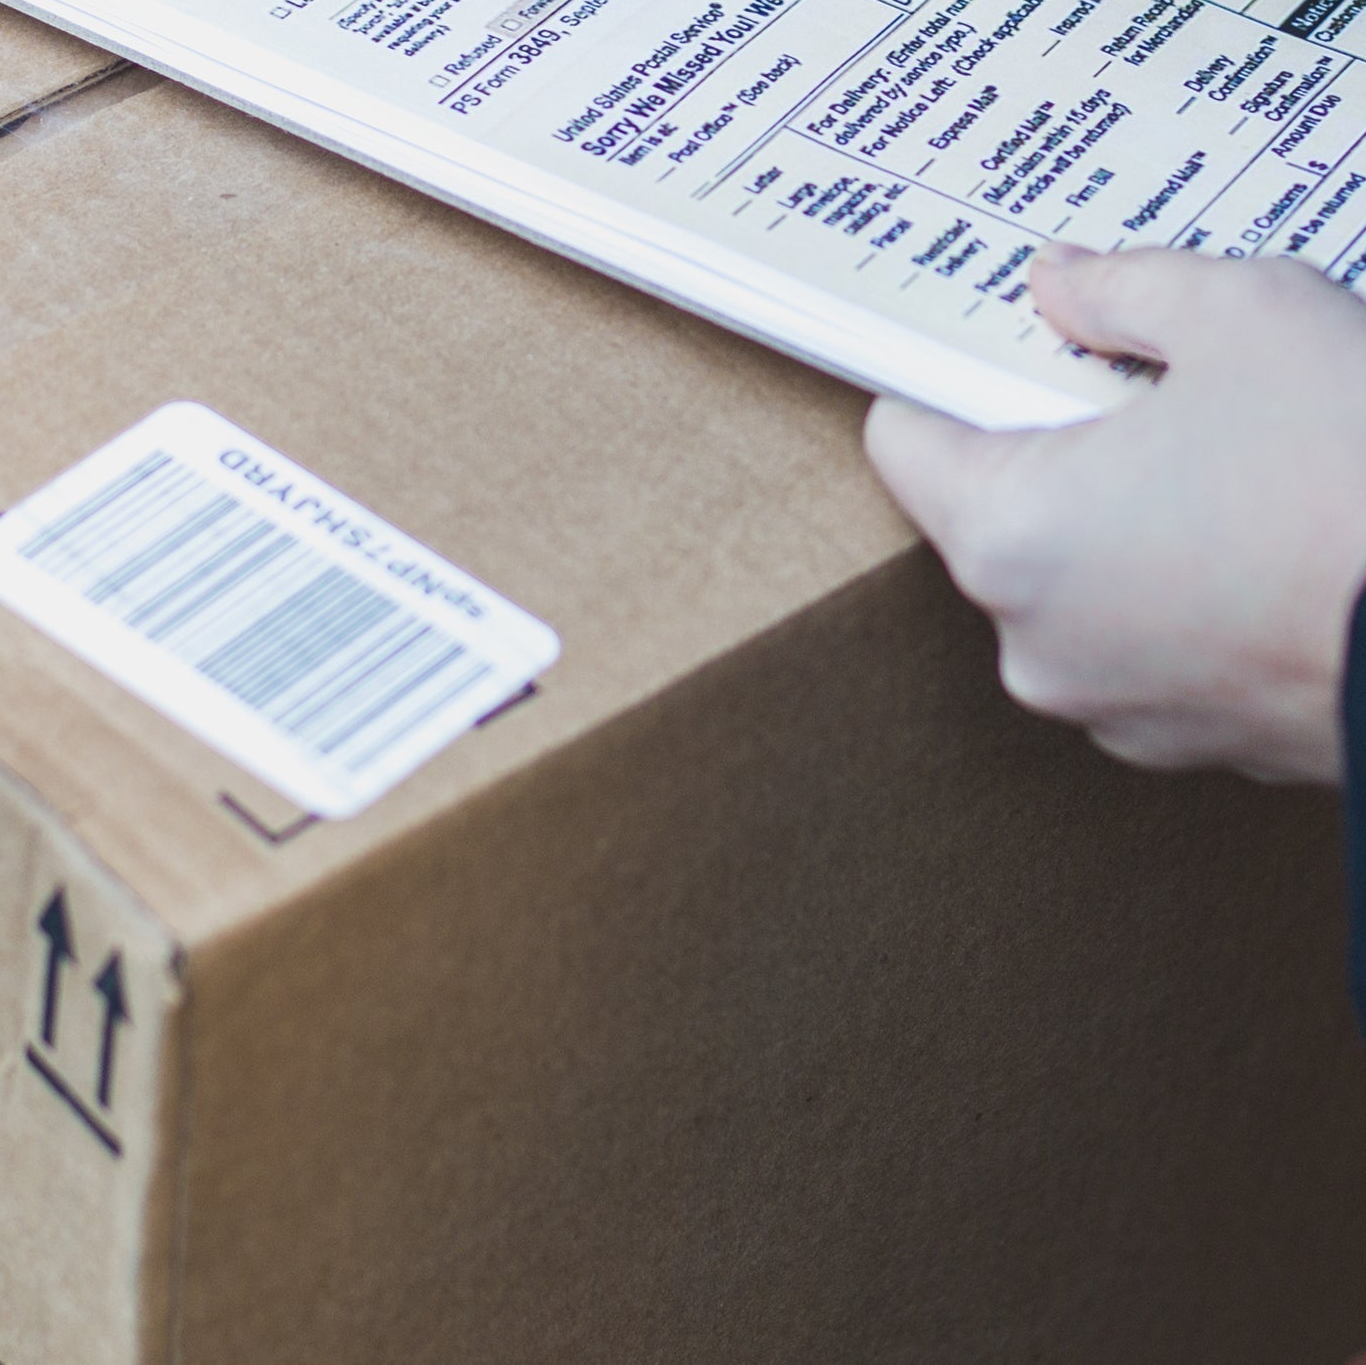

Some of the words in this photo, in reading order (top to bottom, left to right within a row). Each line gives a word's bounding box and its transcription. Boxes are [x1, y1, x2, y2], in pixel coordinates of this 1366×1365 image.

[1049, 0, 1096, 36] Insured
[443, 33, 503, 75] Refused
[1100, 25, 1144, 57] Return
[1122, 49, 1149, 66] for
[449, 93, 482, 115] PS
[472, 64, 521, 96] Form
[507, 27, 572, 65] 3849,
[552, 106, 604, 143] United
[592, 74, 644, 110] States
[630, 40, 683, 77] Postal
[805, 113, 839, 135] For
[884, 35, 927, 67] (Enter
[917, 12, 952, 38] total
[1183, 54, 1235, 92] Delivery
[1240, 70, 1295, 114] Signature
[580, 116, 639, 157] Sorry
[624, 93, 667, 119] We
[652, 42, 725, 96] Missed
[667, 139, 704, 163] Post
[735, 80, 772, 106] (See
[760, 53, 803, 83] back)
[832, 96, 892, 146] delivered
[880, 83, 908, 100] by
[898, 51, 945, 87] service
[858, 135, 890, 157] For
[880, 101, 930, 138] Notice
[950, 37, 999, 76] (Check
[1079, 88, 1113, 114] days
[927, 111, 979, 150] Express
[1270, 115, 1322, 158] Amount
[1310, 94, 1342, 117] Due
[618, 145, 652, 166] Item
[642, 135, 664, 146] is
[979, 129, 1032, 171] Certified
[1048, 156, 1074, 175] will
[1063, 144, 1088, 159] be
[1308, 160, 1330, 171] $
[1065, 184, 1099, 207] Firm
[1088, 167, 1115, 185] Bill
[1122, 179, 1184, 231] Registered
[1253, 183, 1309, 229] Customs
[1285, 231, 1311, 254] will
[1300, 218, 1325, 235] be
